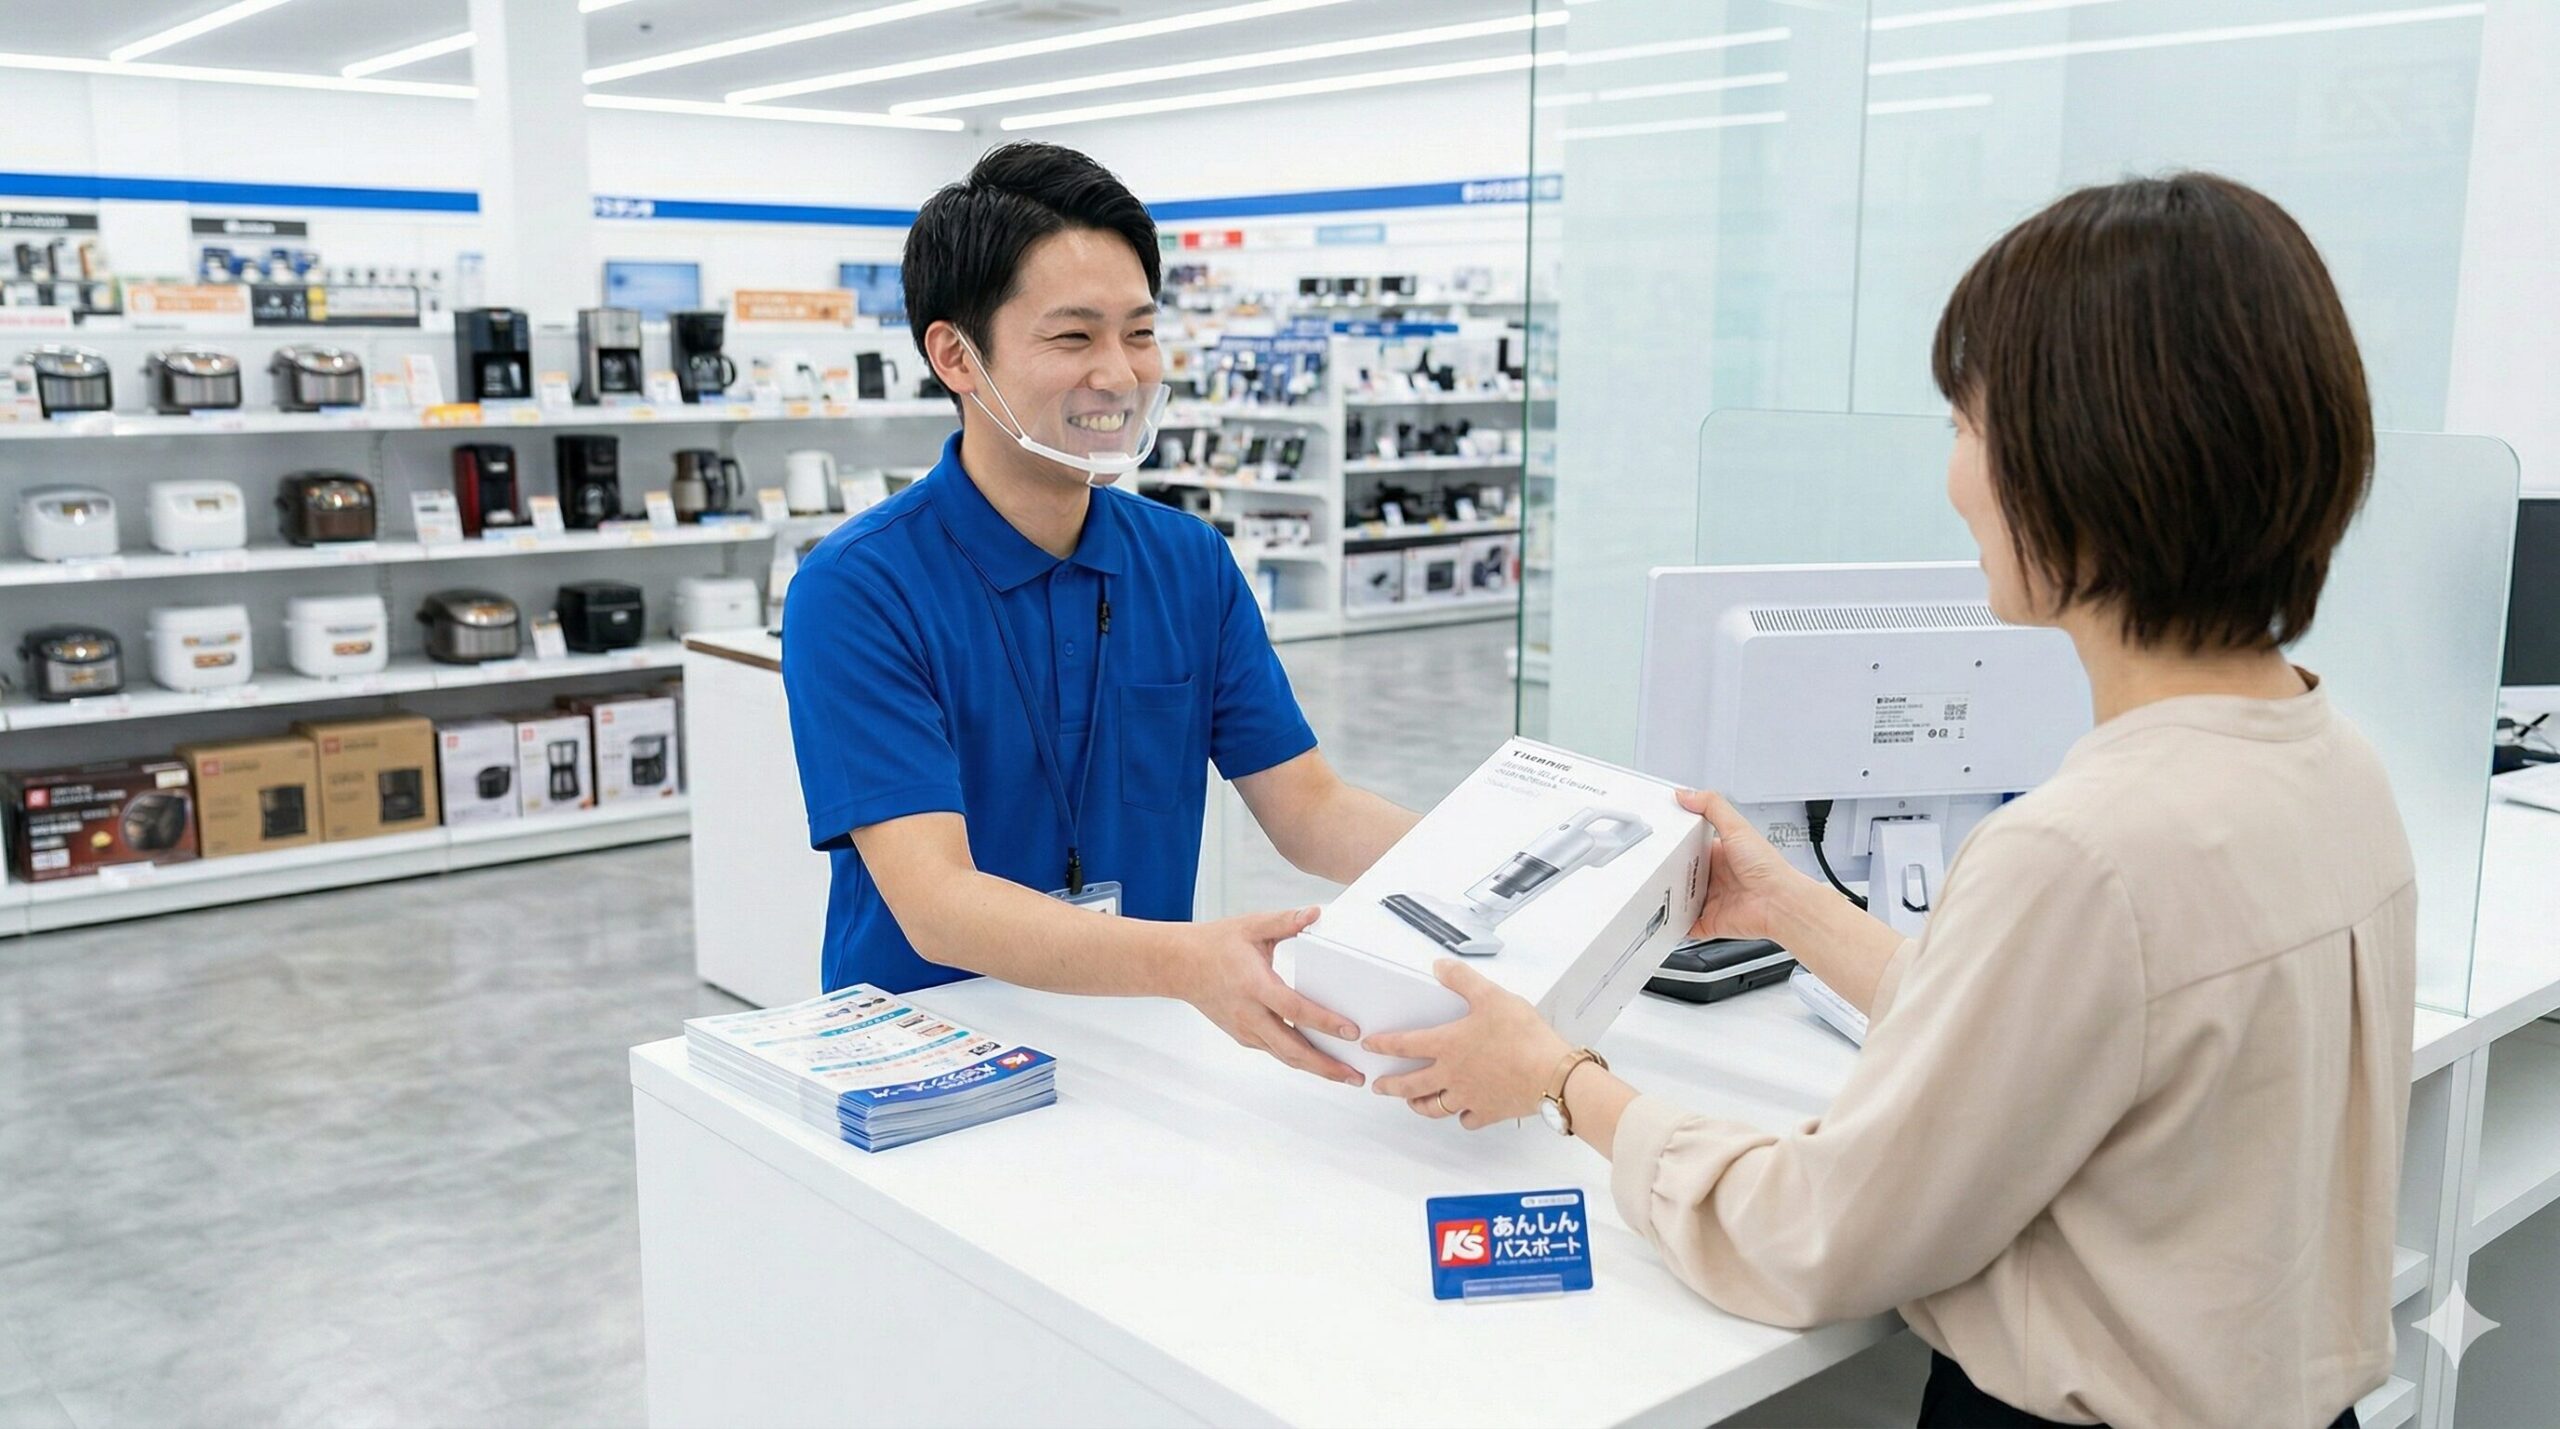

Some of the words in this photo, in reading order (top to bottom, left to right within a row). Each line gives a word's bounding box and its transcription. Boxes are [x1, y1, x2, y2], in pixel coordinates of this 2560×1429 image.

[1492, 1211, 1580, 1237] あんしん
[1441, 1224, 1486, 1261] K's
[1494, 1236, 1582, 1258] パスポート
